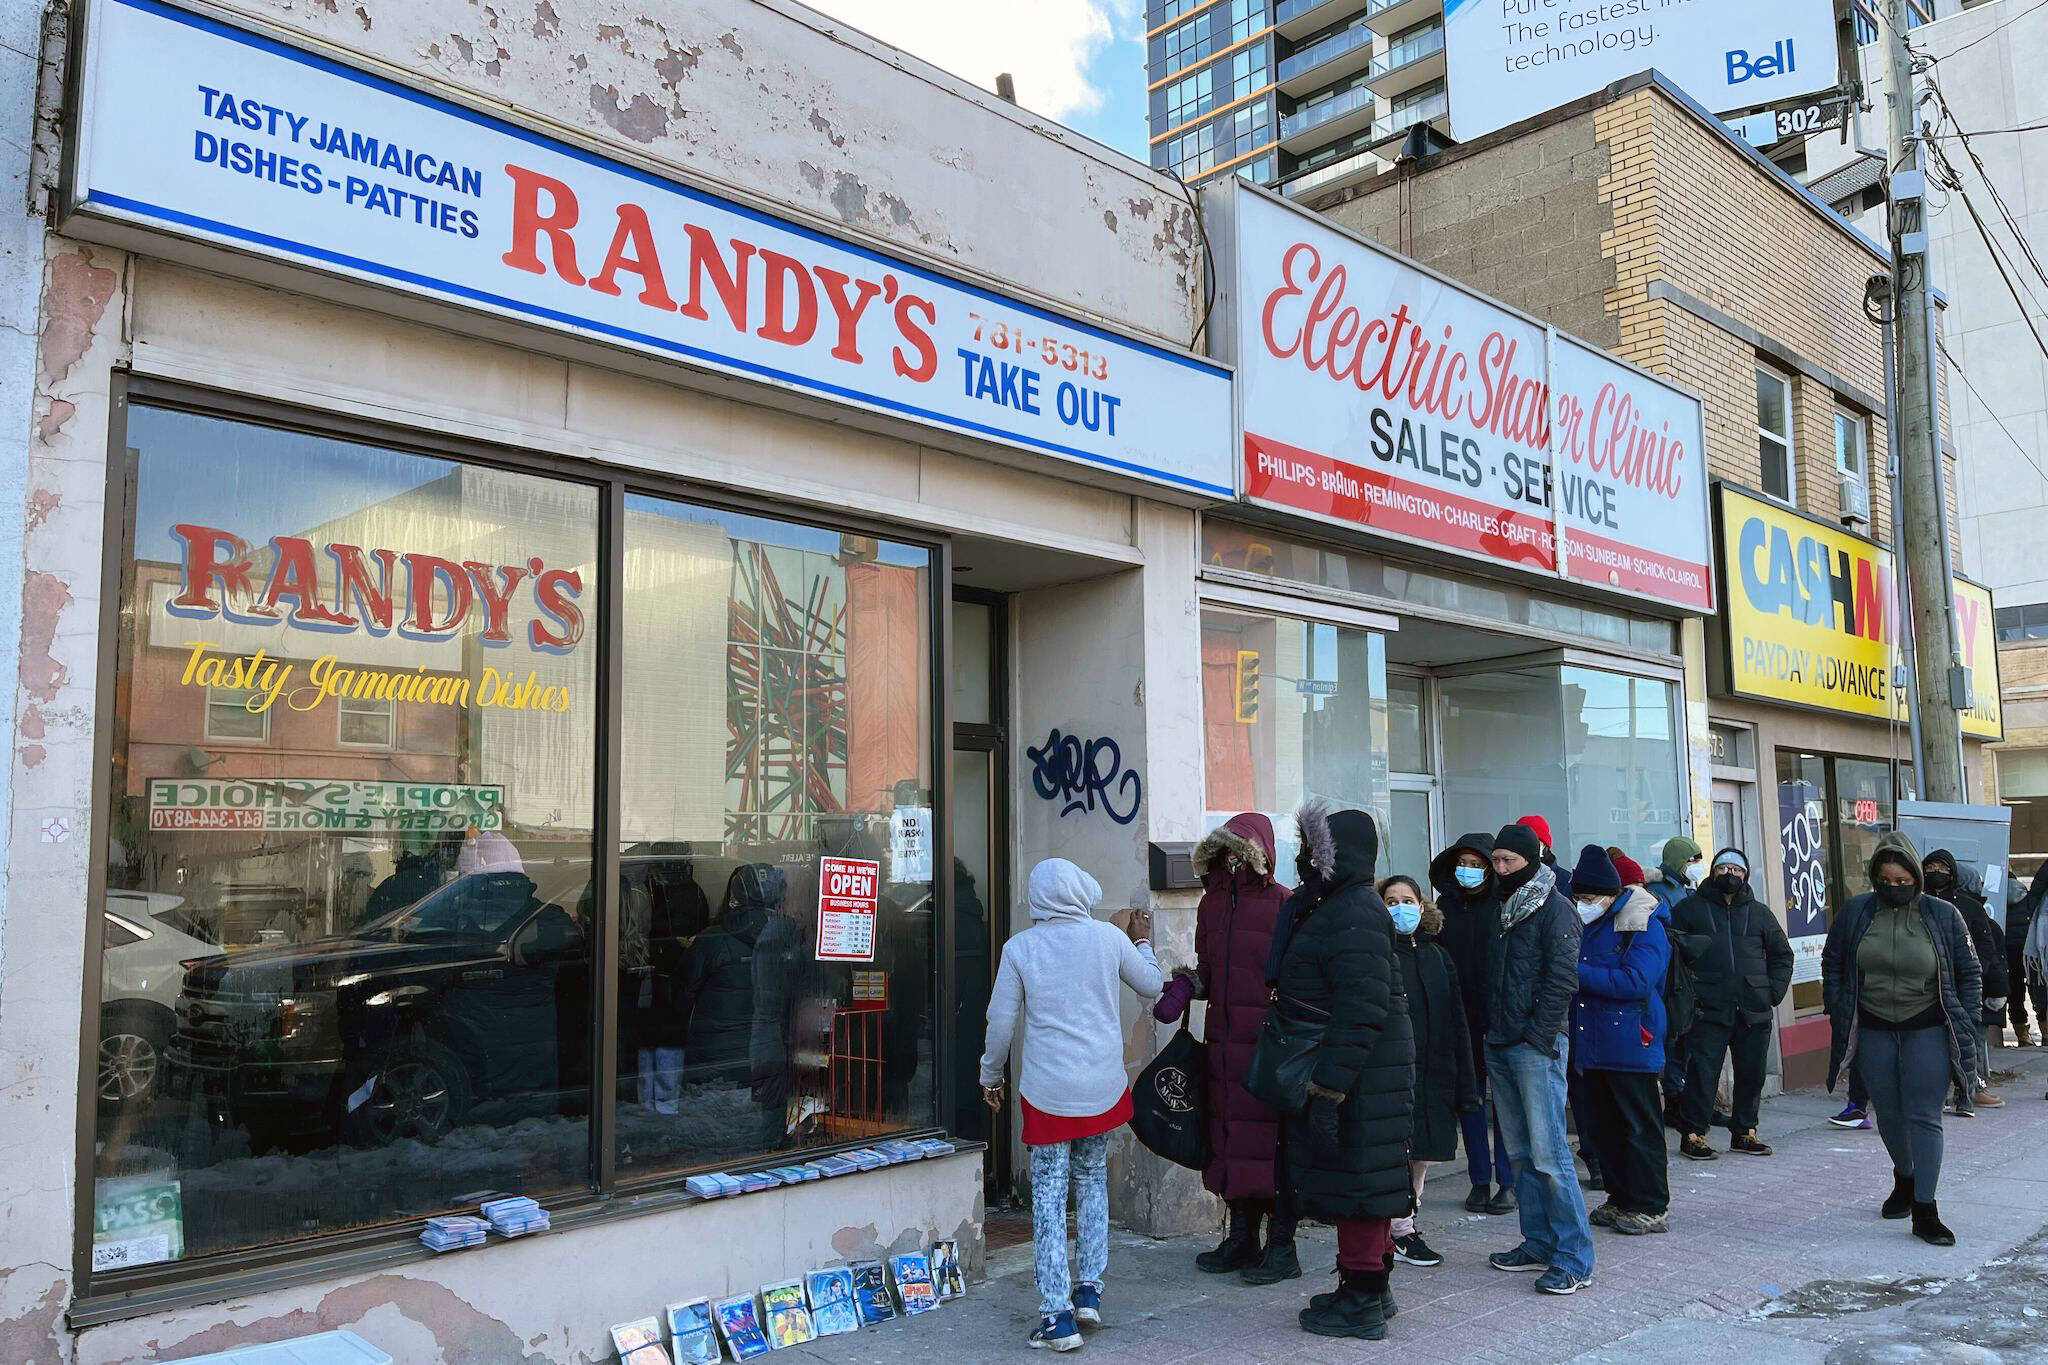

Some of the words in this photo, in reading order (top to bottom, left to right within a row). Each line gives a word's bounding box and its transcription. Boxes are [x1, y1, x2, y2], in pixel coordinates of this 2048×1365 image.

[1502, 22, 1549, 45] The
[1558, 0, 1650, 32] fastest
[1505, 24, 1661, 73] technology.
[1725, 38, 1796, 85] Bell
[198, 84, 309, 144] TASTY
[310, 121, 483, 198] JAMAICAN
[1777, 105, 1823, 136] 302
[502, 163, 938, 383] RANDY'S
[968, 311, 1109, 381] 781-5313
[1262, 242, 1467, 421] Electric
[1589, 382, 1684, 500] Clinic
[957, 347, 1041, 416] TAKE
[1056, 380, 1121, 436] OUT
[1370, 407, 1482, 488] SALES
[1258, 452, 1316, 488] PHILIPS
[1364, 483, 1441, 521] REMINGTON
[1443, 505, 1500, 537] CHARLES
[1500, 521, 1537, 545] CRAFT
[1542, 534, 1584, 559] ROSON
[1586, 547, 1631, 571] SUNBEAM
[1633, 558, 1666, 580] SCHICK
[1668, 568, 1702, 589] CLAIROL
[165, 523, 586, 655] RANDY'S
[181, 641, 294, 714] Tasty
[287, 654, 470, 712] Jamaican
[475, 666, 571, 713] Dishes
[1743, 636, 1810, 685] PAYDAY
[1814, 654, 1886, 701] ADVANCE
[1855, 800, 1877, 822] OPEN
[825, 864, 846, 873] COME
[847, 865, 855, 874] IN
[856, 866, 876, 876] WE'RE
[830, 873, 871, 896] OPEN
[1792, 860, 1826, 924] $20
